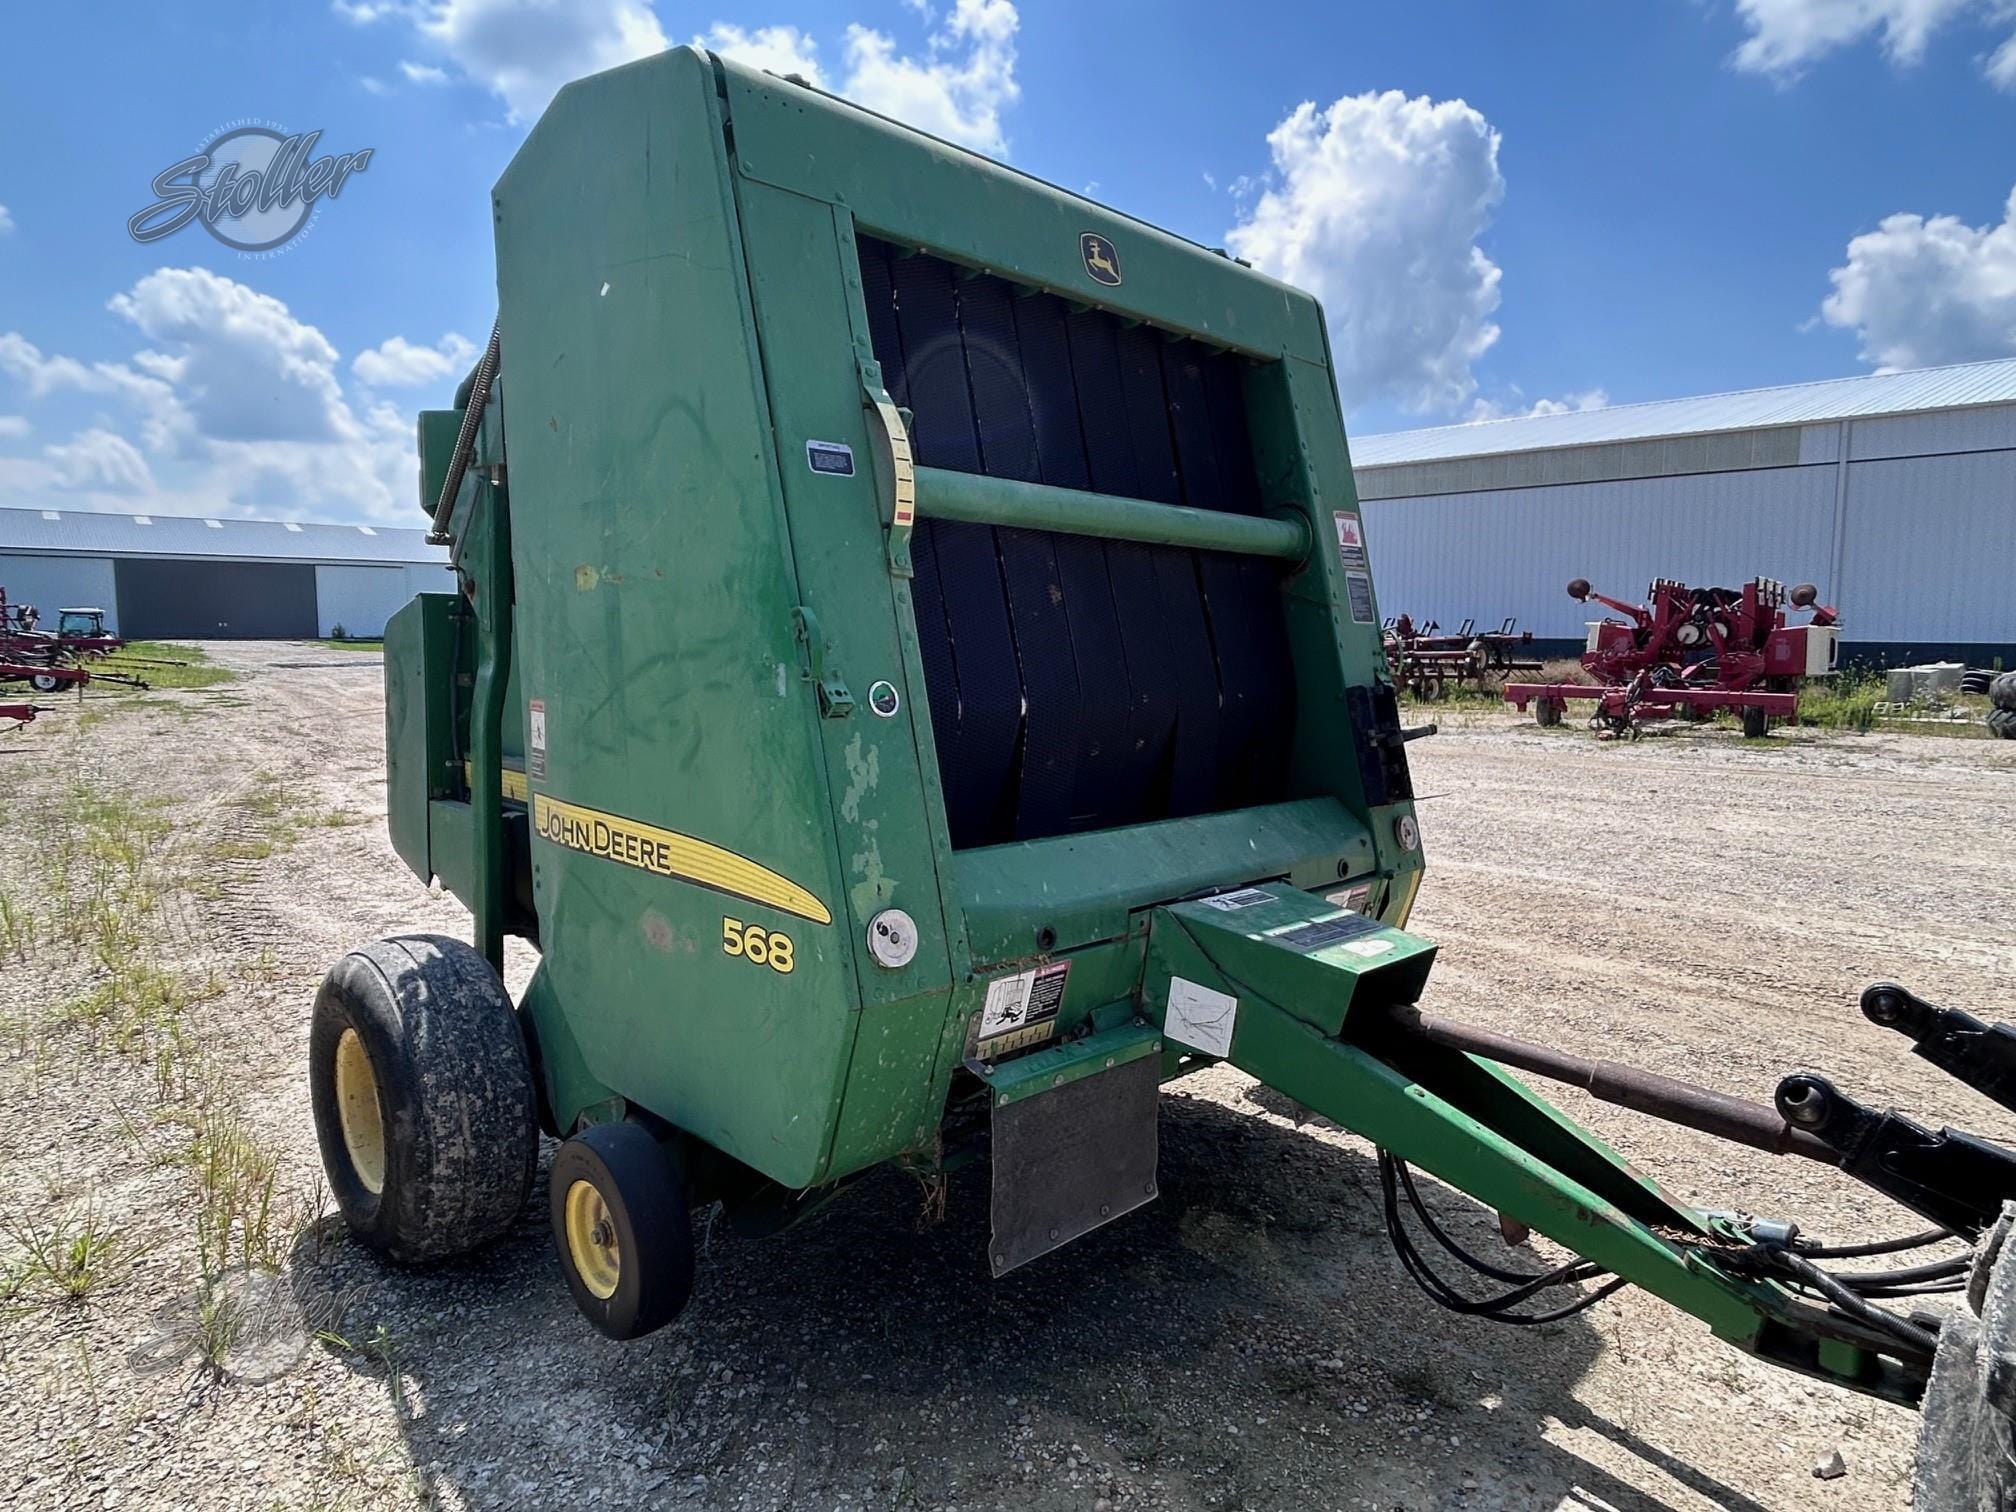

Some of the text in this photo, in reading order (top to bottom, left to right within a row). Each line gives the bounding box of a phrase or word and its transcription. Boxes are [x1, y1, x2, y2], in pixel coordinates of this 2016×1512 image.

[541, 806, 671, 871] JOHN DEERE
[722, 915, 795, 974] 568
